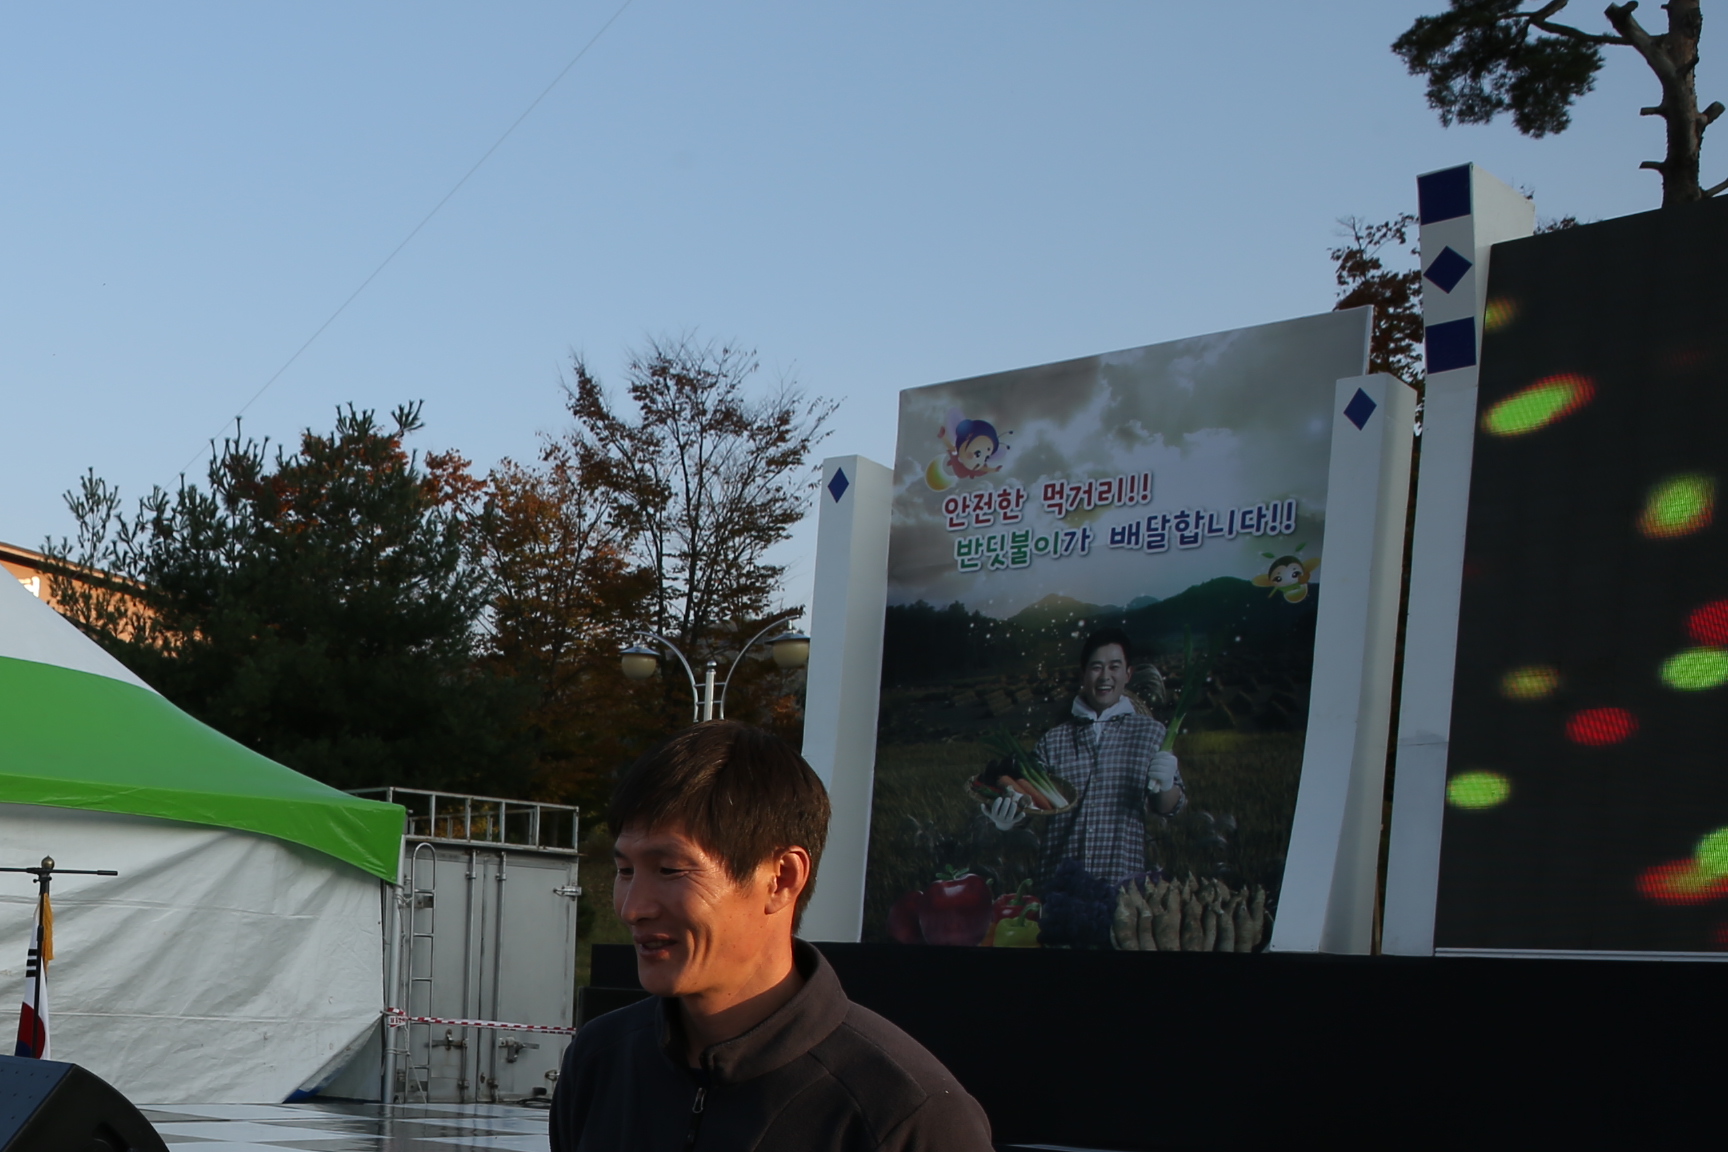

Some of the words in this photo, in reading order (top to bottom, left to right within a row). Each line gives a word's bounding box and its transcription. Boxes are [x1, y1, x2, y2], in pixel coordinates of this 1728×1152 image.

[943, 486, 1026, 527] 안전한
[1042, 473, 1152, 516] 먹거리!!!
[955, 526, 1091, 569] 반딧불이가
[1109, 499, 1297, 551] 배달합니다!!
